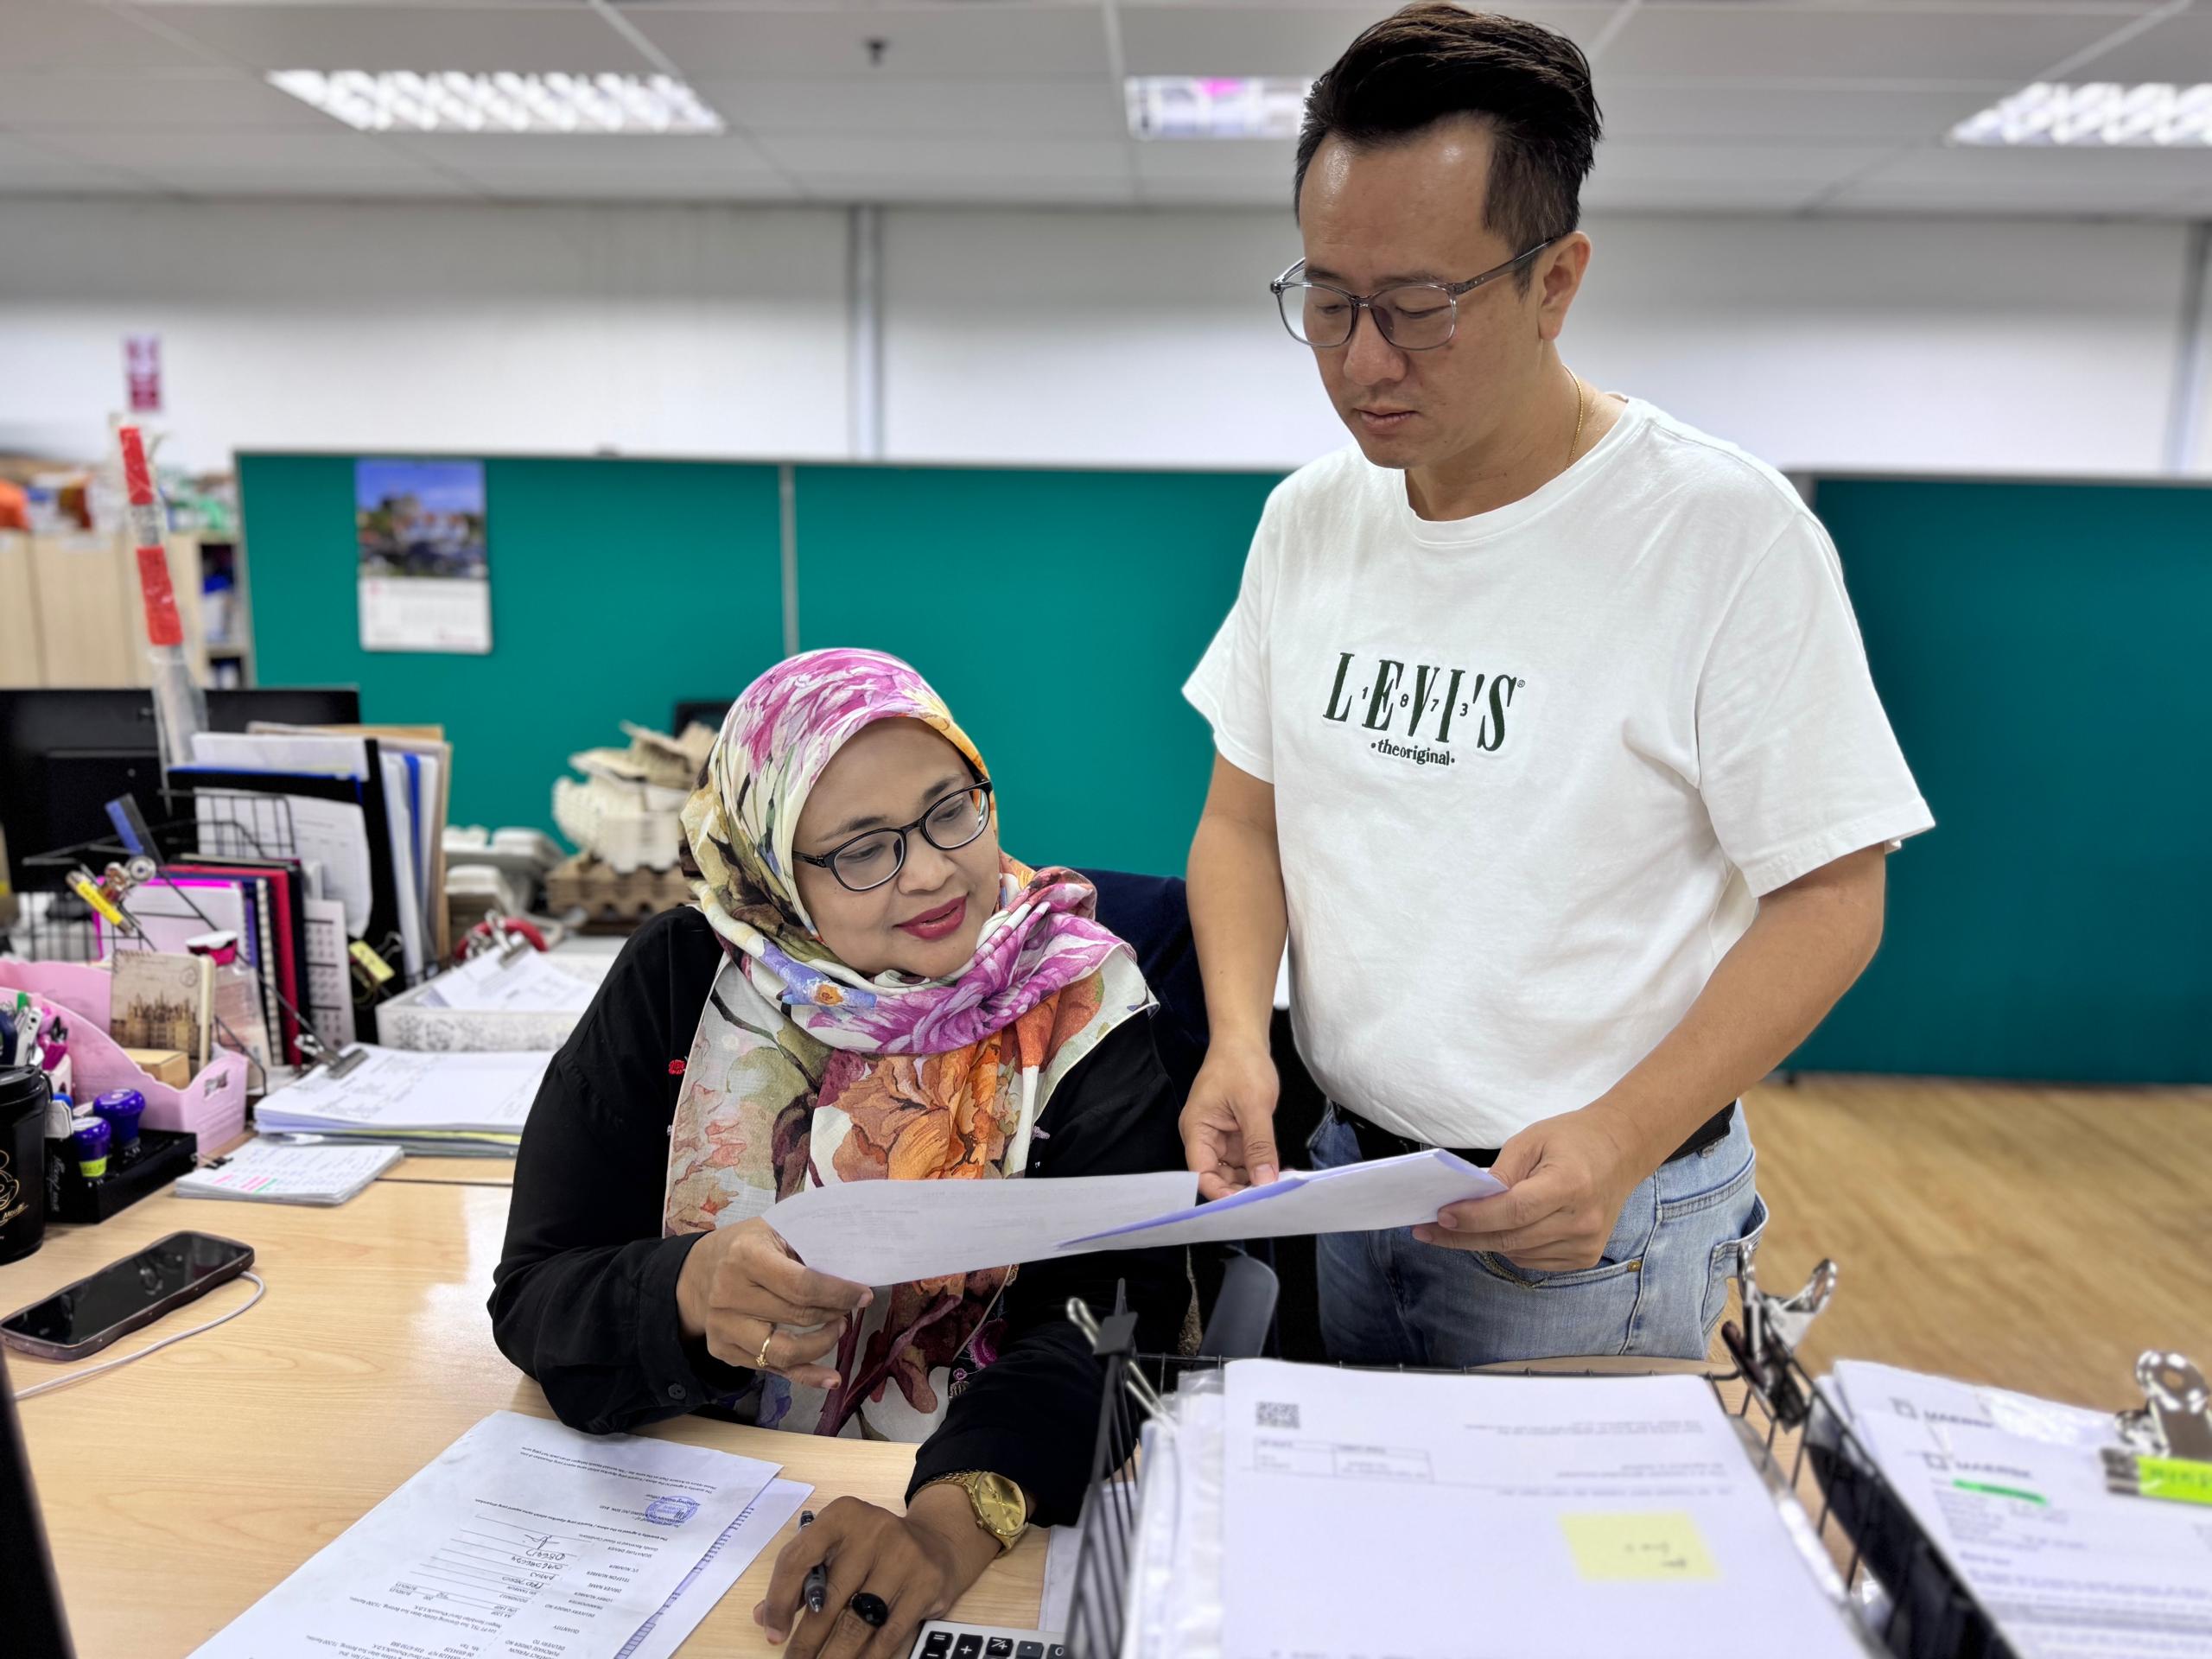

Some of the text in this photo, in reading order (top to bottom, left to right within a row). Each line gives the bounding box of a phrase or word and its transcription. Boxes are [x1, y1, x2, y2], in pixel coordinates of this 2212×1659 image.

[625, 1549, 652, 1558] SIGNATURE
[567, 1599, 603, 1609] TRANSPORTER
[552, 1624, 581, 1633] QUANTITY
